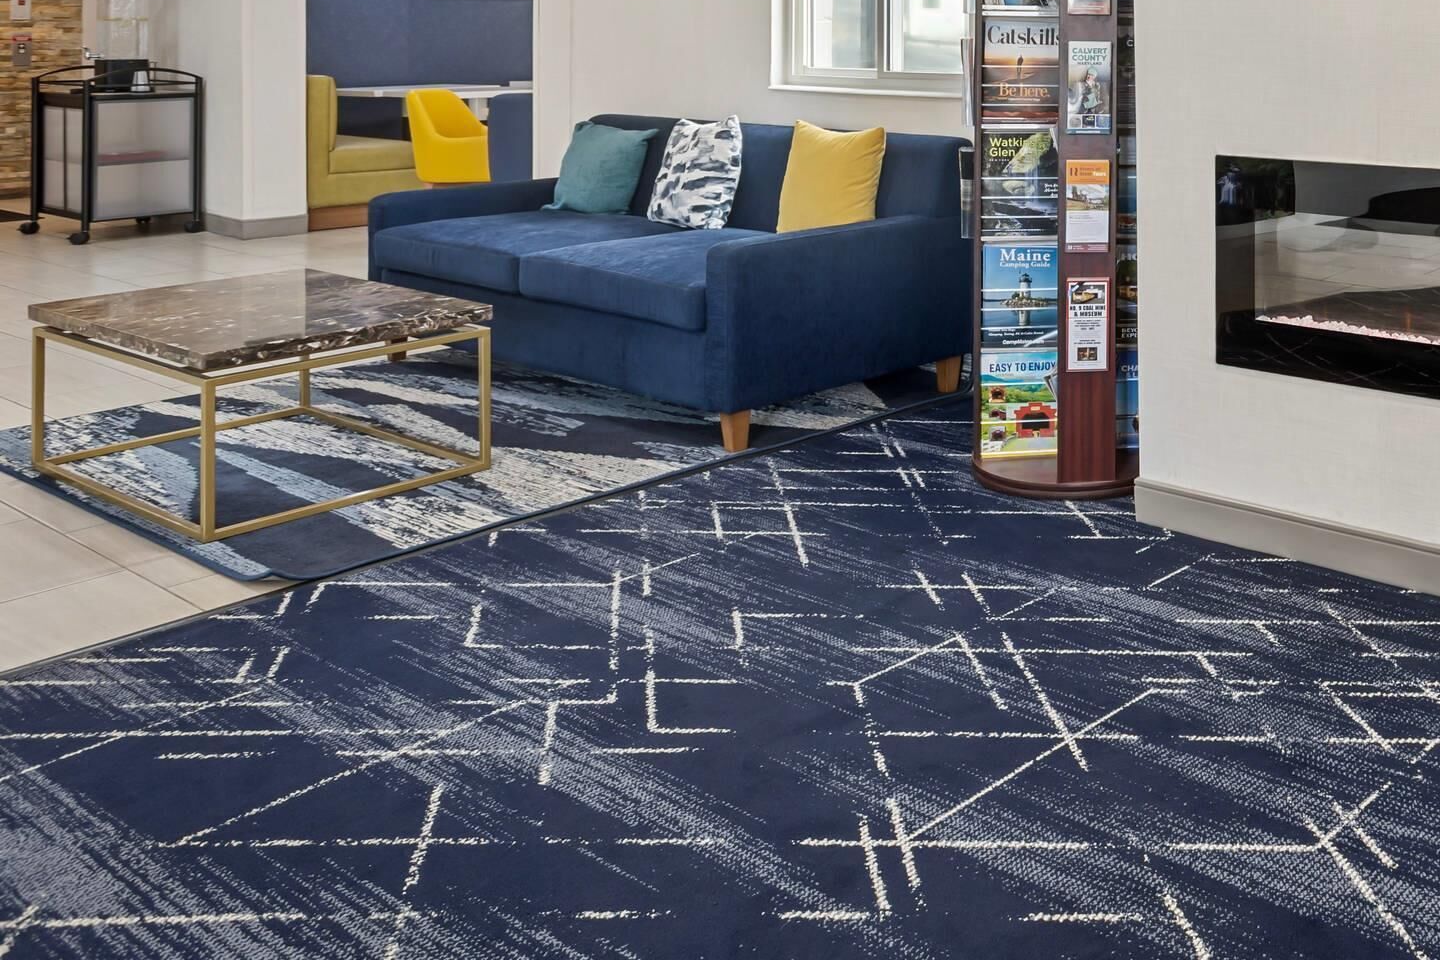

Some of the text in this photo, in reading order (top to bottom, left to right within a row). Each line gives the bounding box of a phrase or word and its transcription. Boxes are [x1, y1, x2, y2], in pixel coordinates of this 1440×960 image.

[987, 25, 1059, 46] Catskills
[1072, 47, 1108, 55] CALVERT
[1072, 54, 1107, 62] COUNTY
[1000, 82, 1050, 98] Be here.
[989, 137, 1024, 147] Watki
[989, 147, 1016, 157] Glen
[1000, 248, 1051, 261] Maine
[989, 361, 1056, 373] EASY TO ENJOY
